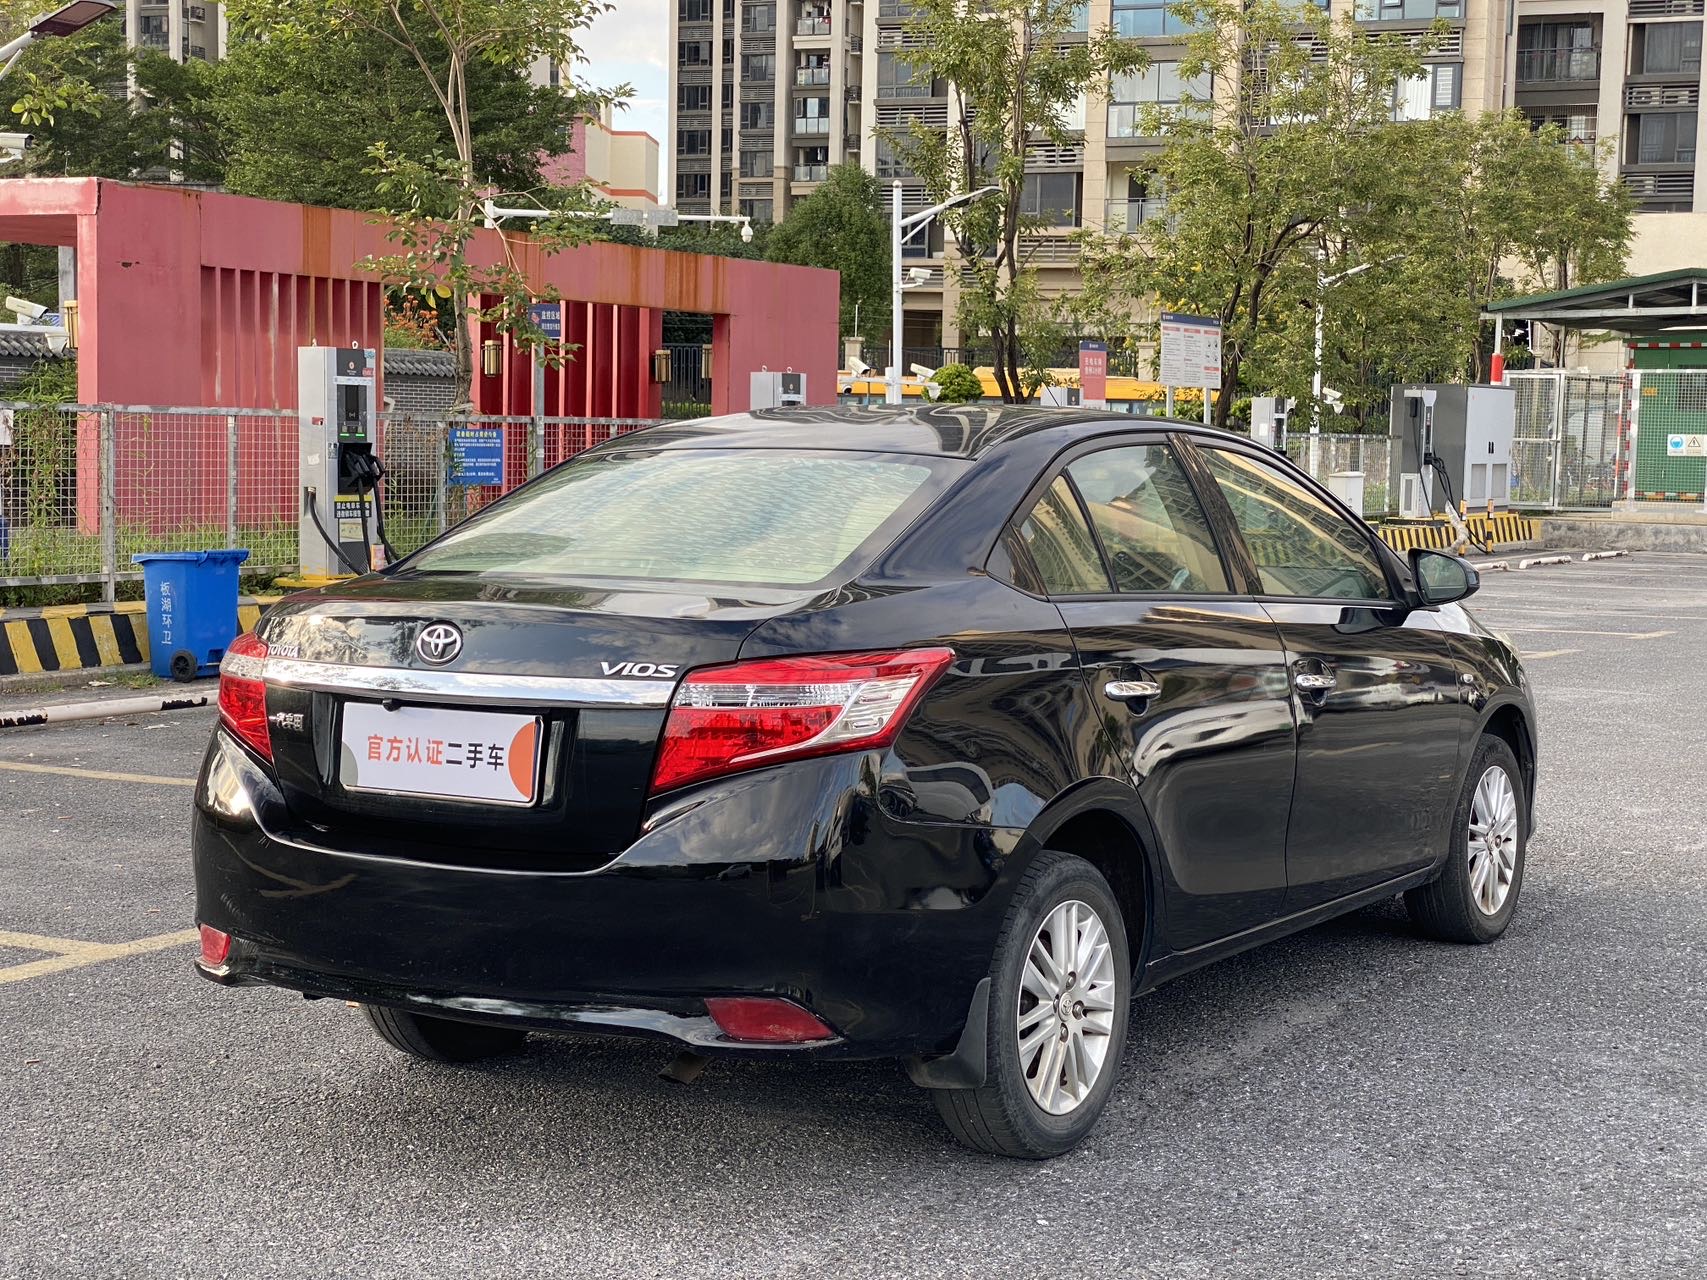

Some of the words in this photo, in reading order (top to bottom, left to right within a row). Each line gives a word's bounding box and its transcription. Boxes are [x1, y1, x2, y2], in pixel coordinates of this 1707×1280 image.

[160, 581, 173, 645] 板湖环卫
[267, 643, 300, 658] TOYOTA
[600, 661, 680, 678] VIOS
[367, 734, 505, 771] 官方认证二手车
